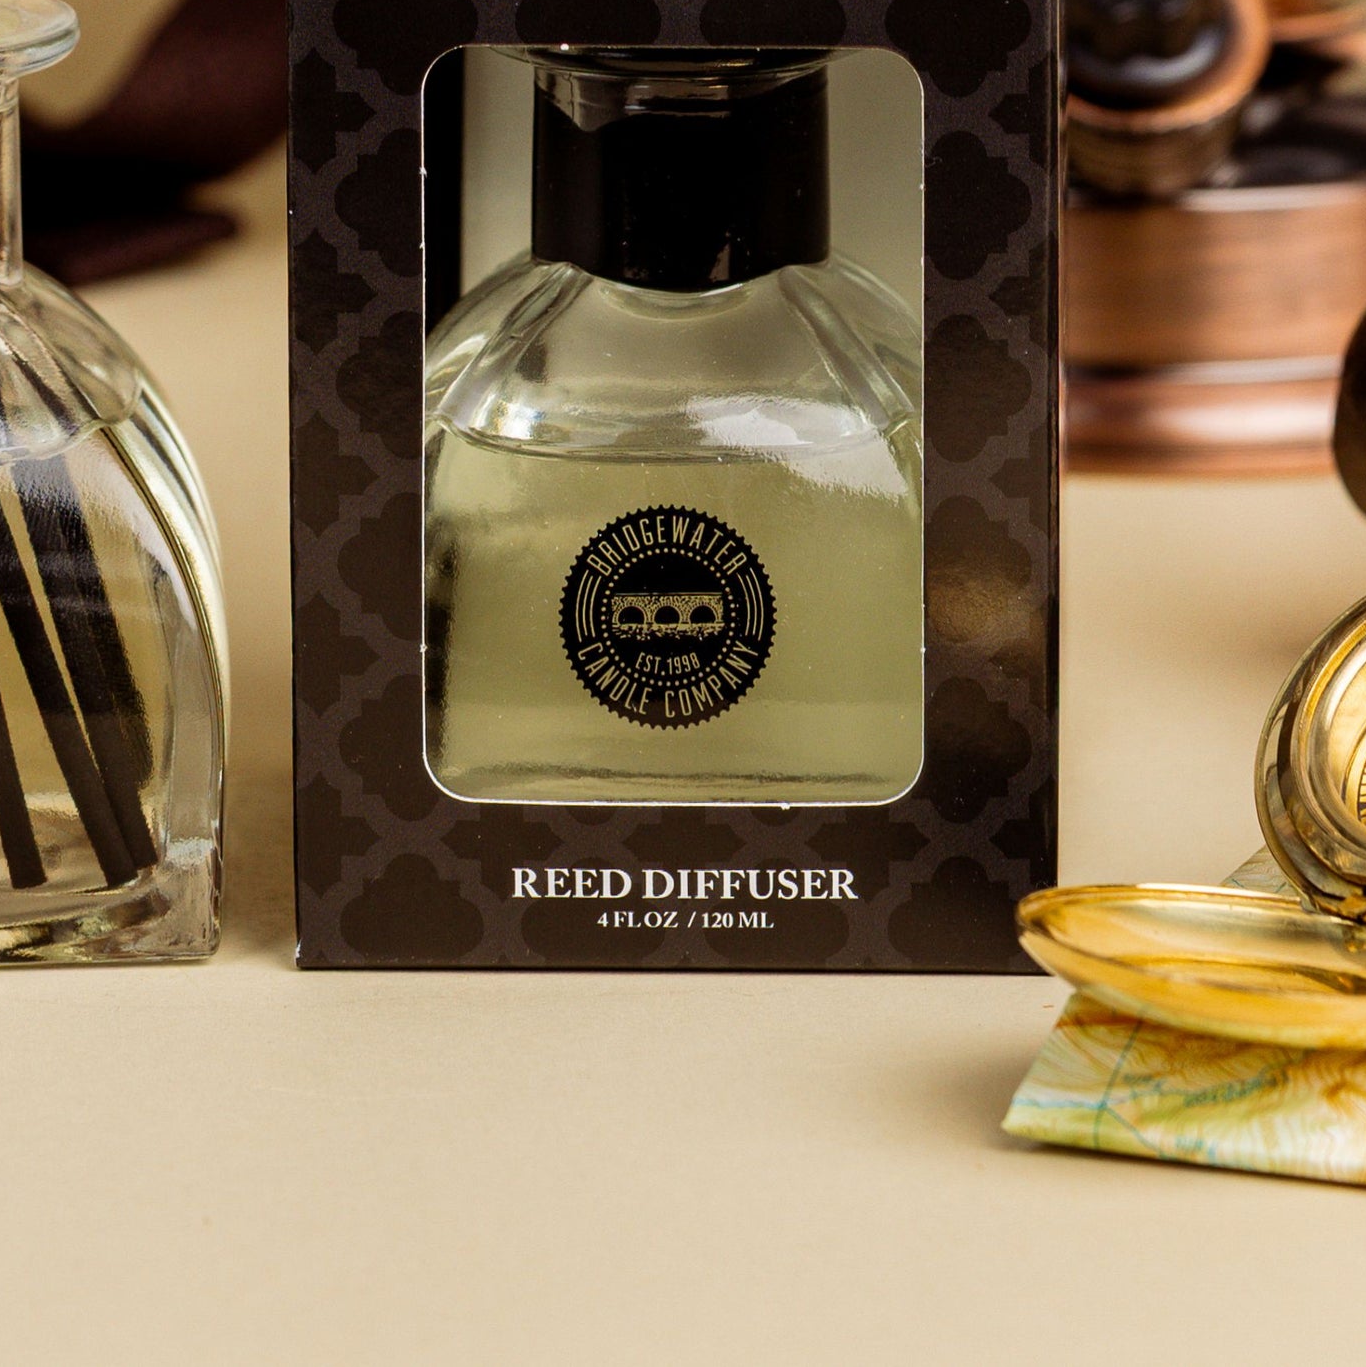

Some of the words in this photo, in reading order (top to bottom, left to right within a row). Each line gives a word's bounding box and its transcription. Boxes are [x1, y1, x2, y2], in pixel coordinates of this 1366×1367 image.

[586, 515, 748, 577] BRIDGEWATER
[577, 642, 653, 715] CANDLE
[664, 640, 759, 718] COMPANY
[511, 867, 632, 900] REED
[641, 867, 859, 900] DIFFUSER
[597, 911, 609, 928] 4
[687, 911, 698, 929] /
[702, 912, 734, 929] 120
[738, 912, 775, 929] ML
